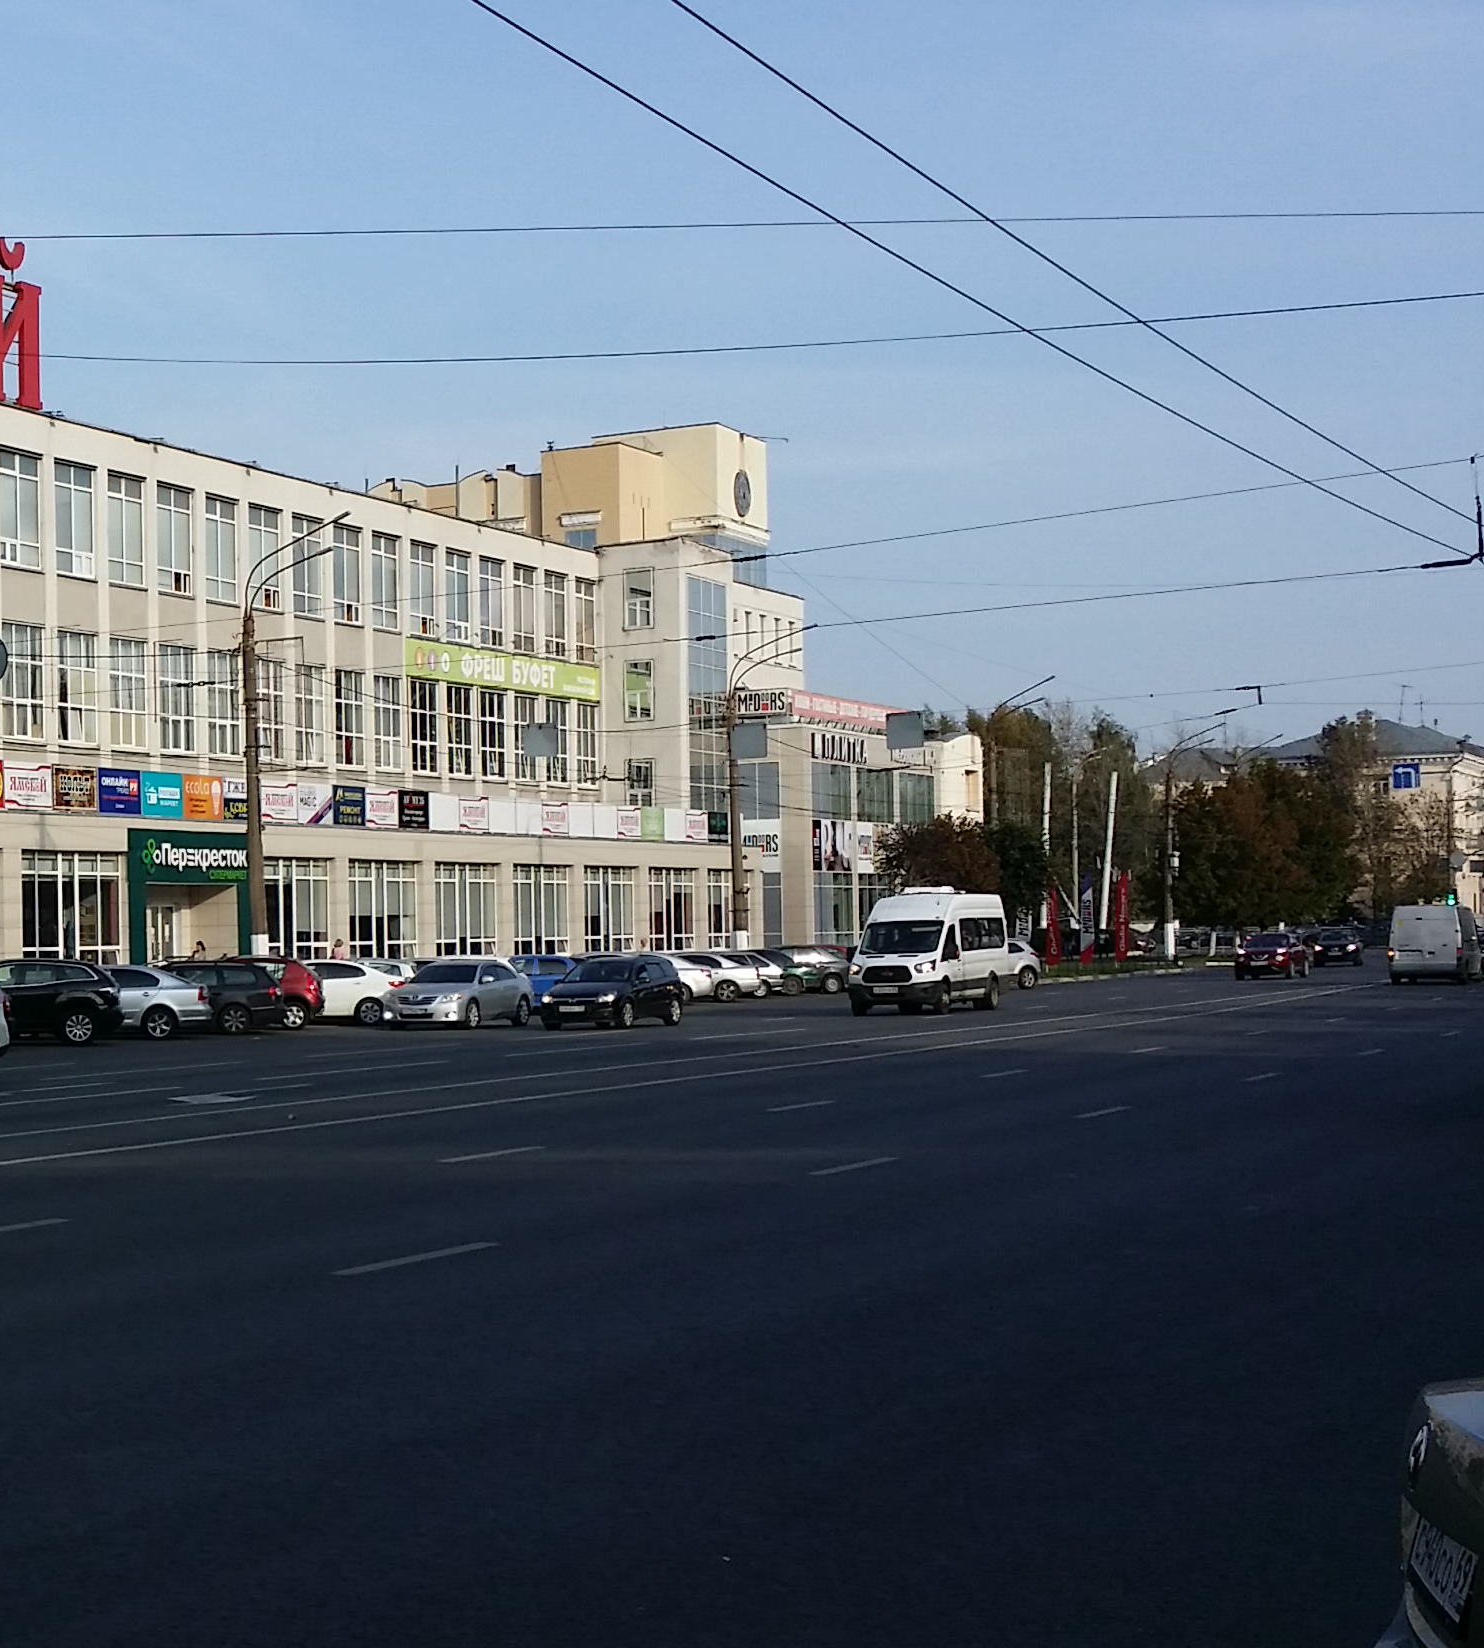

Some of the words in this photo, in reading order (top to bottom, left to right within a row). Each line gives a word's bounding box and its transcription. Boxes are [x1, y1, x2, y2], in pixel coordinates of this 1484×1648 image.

[461, 652, 505, 683] ФРЕШ
[512, 660, 556, 689] БУФЕТ
[101, 776, 129, 787] ОНЛАЙН
